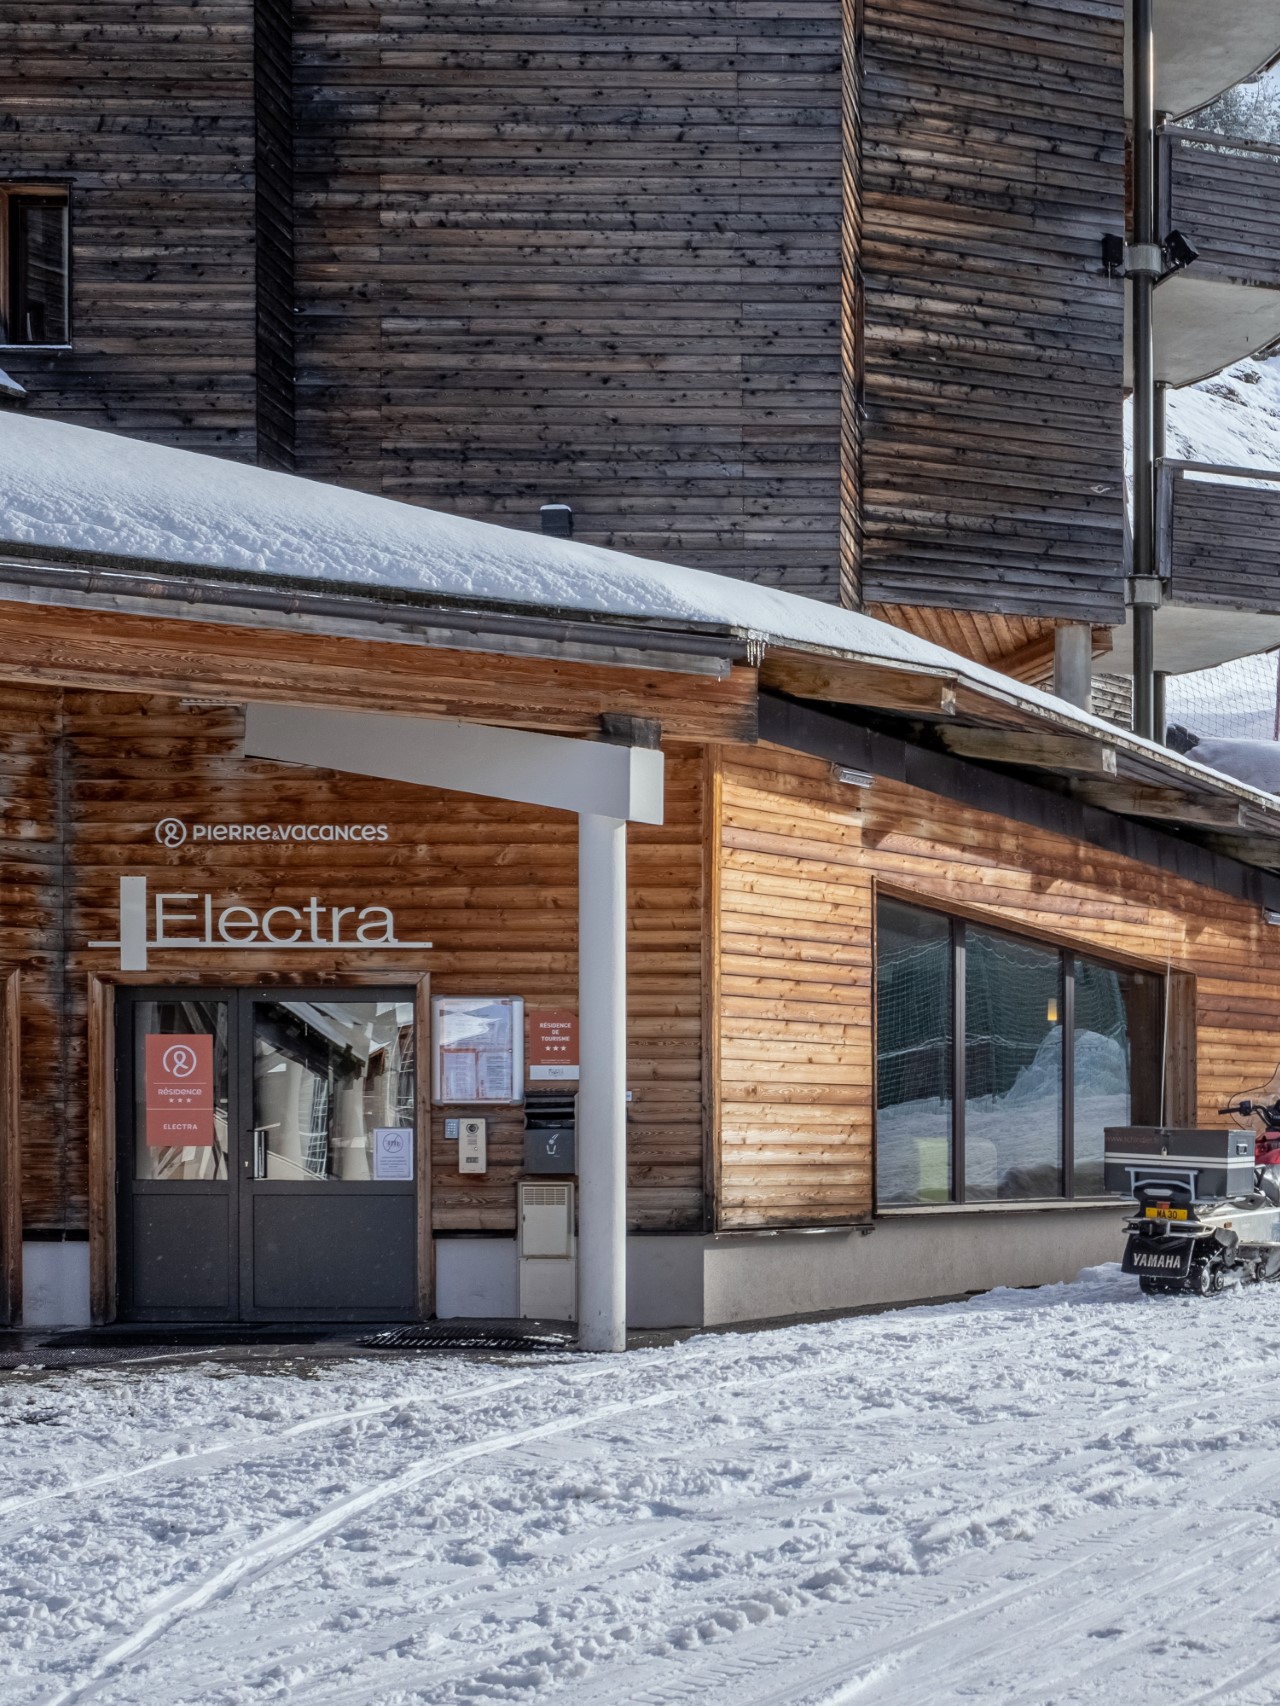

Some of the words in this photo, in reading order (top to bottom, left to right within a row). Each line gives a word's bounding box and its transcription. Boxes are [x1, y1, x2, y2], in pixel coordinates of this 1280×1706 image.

[155, 893, 399, 943] Electra
[1167, 1209, 1178, 1219] 30
[1133, 1252, 1181, 1269] YAMAHA
